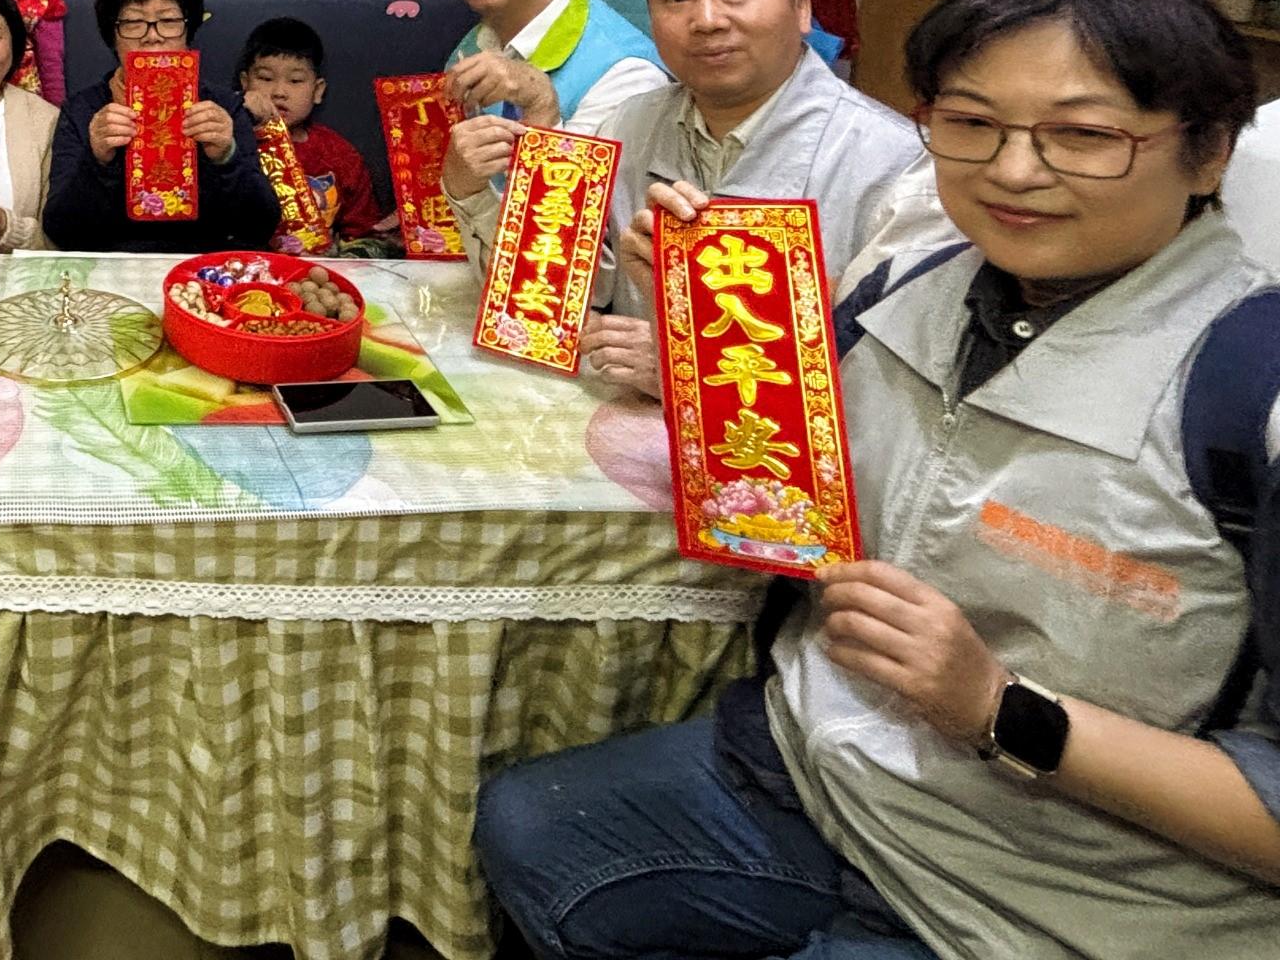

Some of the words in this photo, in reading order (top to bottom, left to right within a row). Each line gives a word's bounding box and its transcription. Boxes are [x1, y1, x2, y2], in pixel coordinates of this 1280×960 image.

[512, 160, 583, 318] 四季平安
[696, 234, 801, 481] 出入平安
